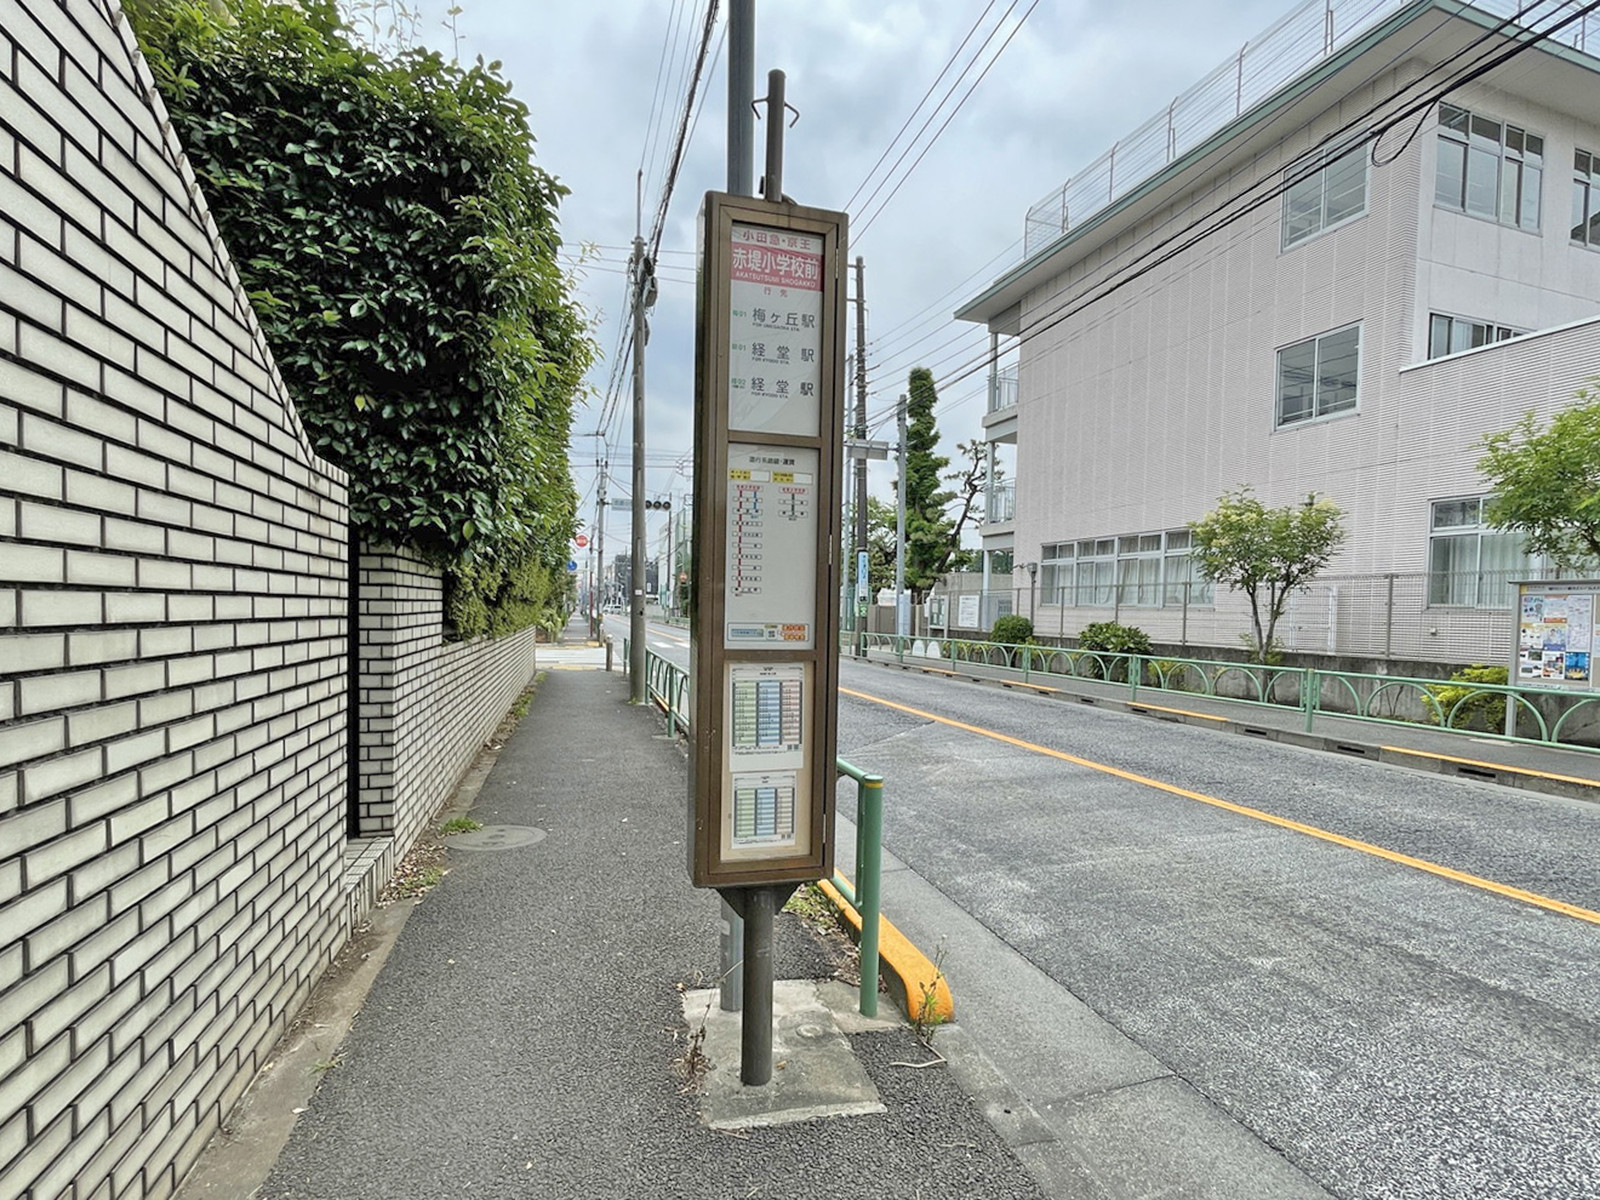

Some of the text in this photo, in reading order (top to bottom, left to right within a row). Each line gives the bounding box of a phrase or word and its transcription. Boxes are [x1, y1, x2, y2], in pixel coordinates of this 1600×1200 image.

[743, 229, 811, 250] 小田急・京王
[732, 247, 819, 280] 赤堤小学校前
[781, 277, 816, 288] SHOGAKKO
[752, 342, 815, 363] 経堂駅
[751, 377, 815, 397] 経堂駅
